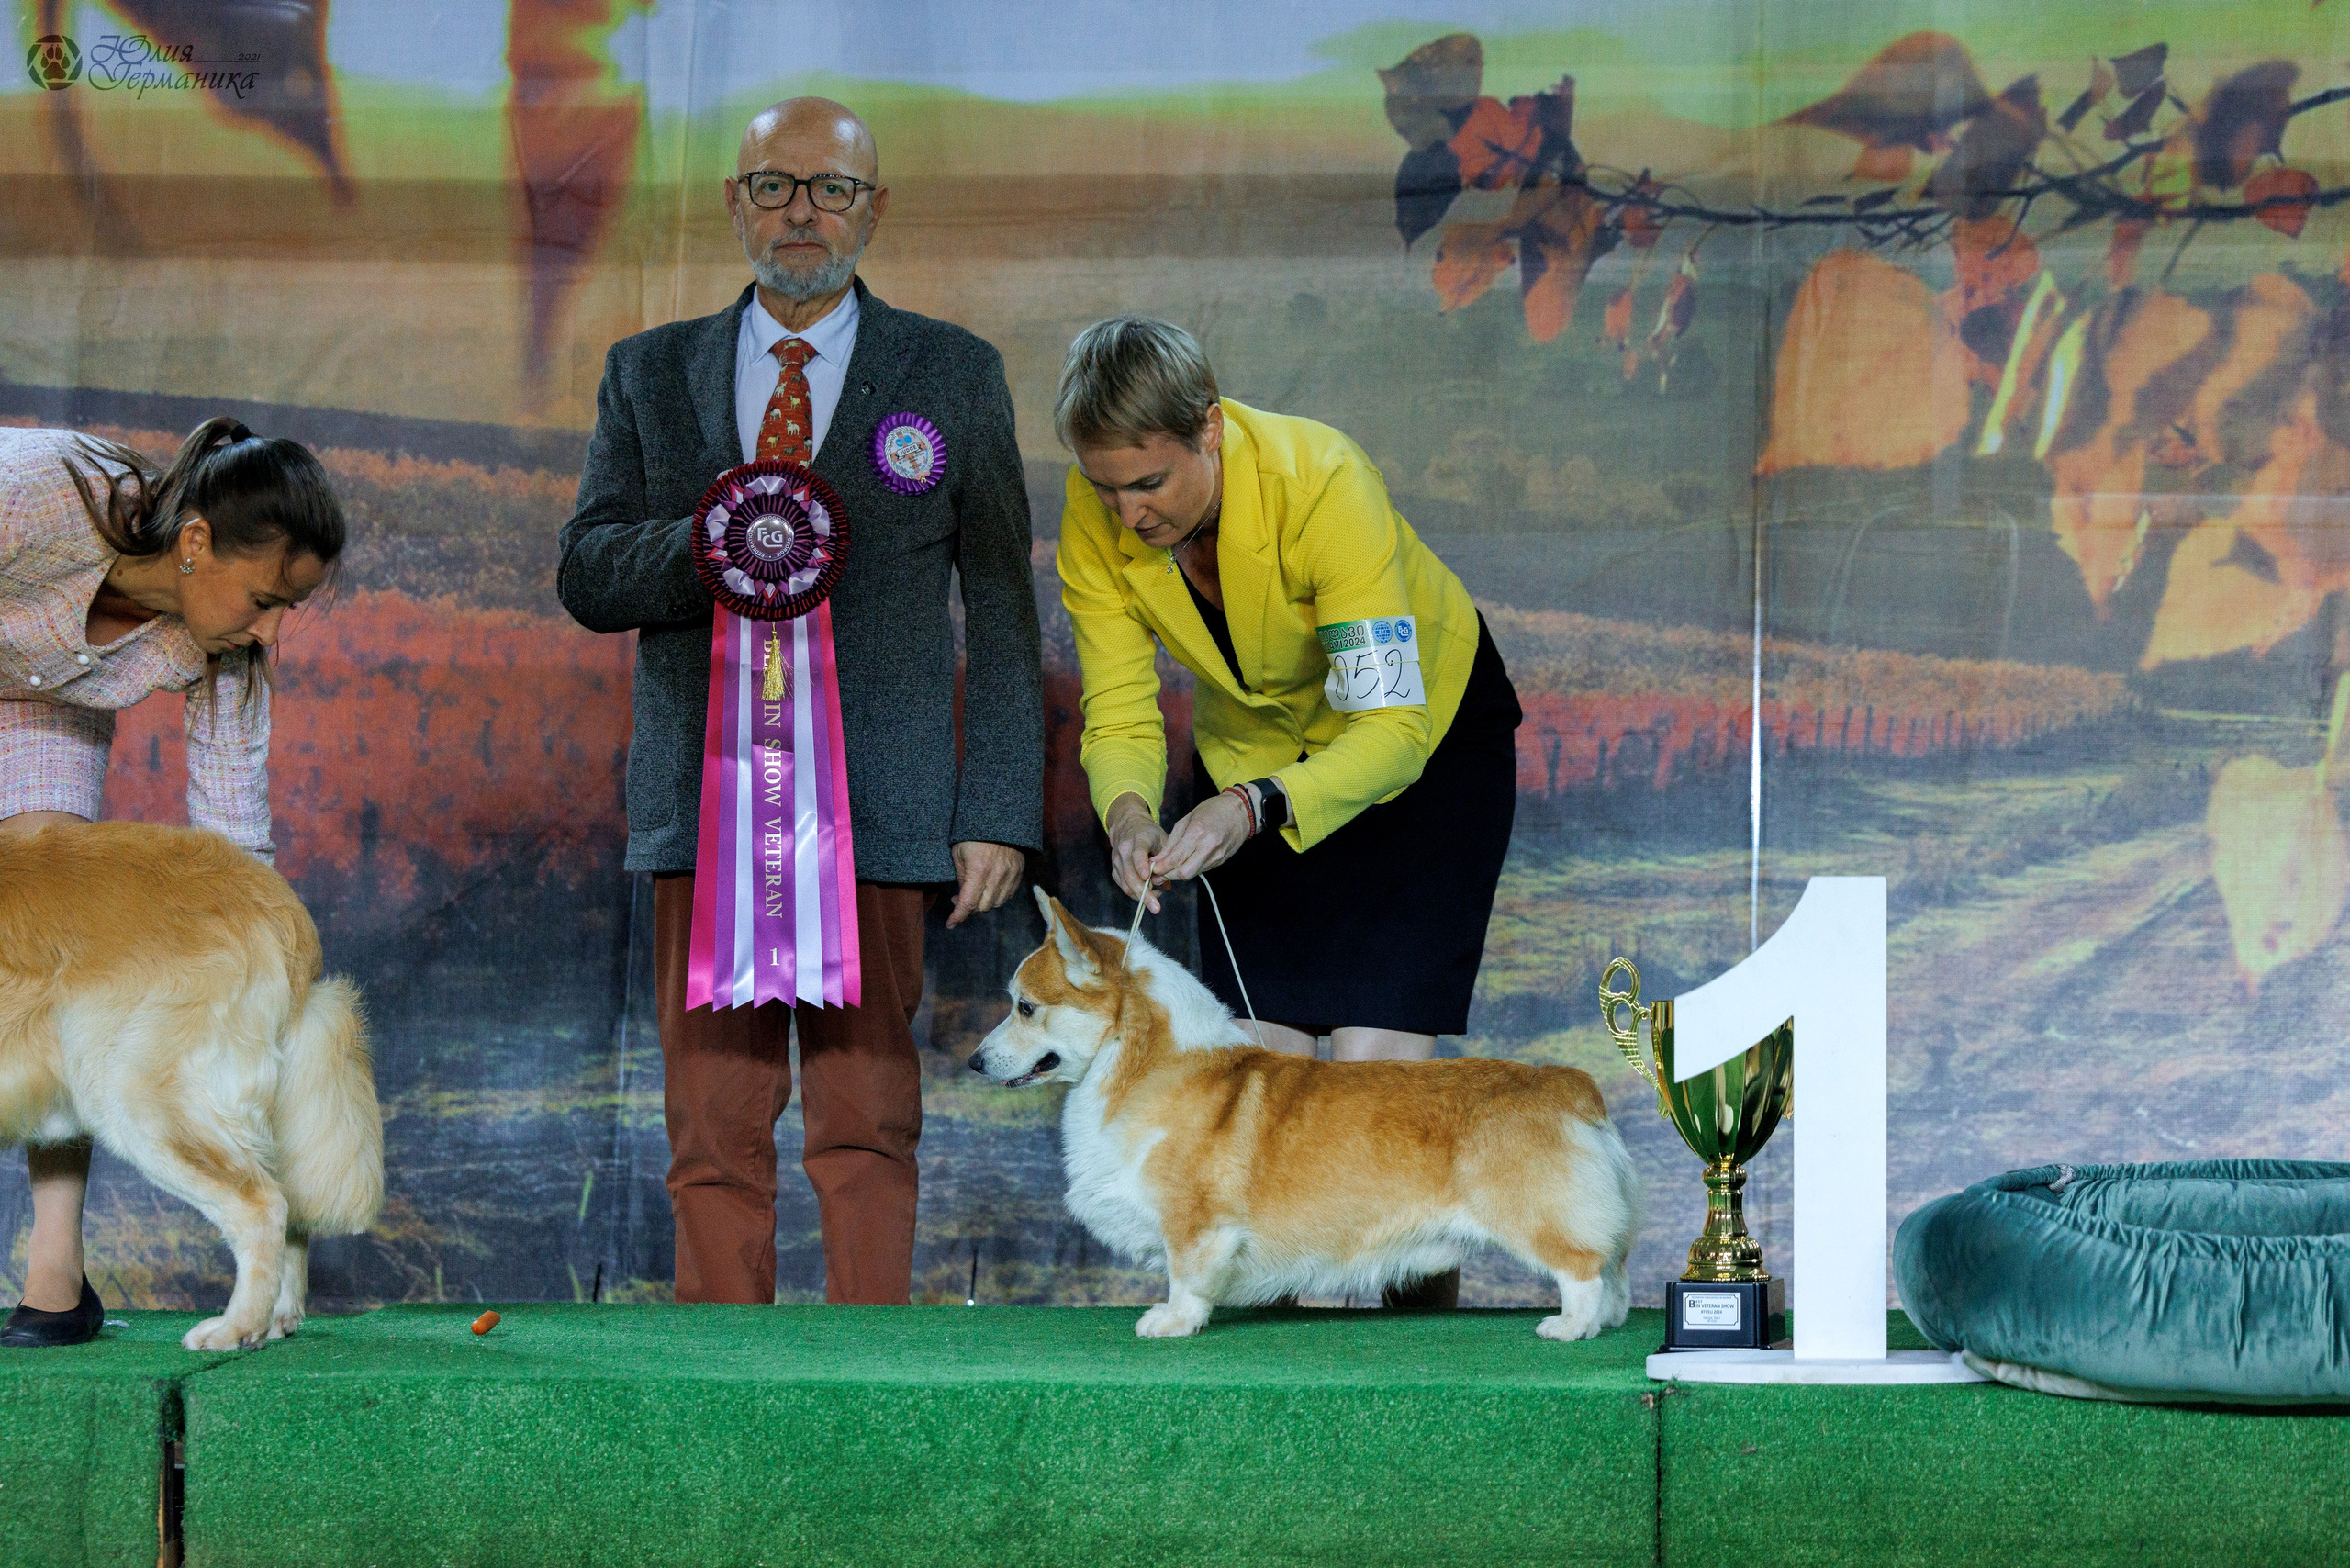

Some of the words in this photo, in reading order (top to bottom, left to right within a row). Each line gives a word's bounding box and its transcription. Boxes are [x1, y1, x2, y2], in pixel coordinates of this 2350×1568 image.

[900, 444, 917, 455] JUDGE
[757, 527, 783, 548] FCG
[1344, 636, 1366, 648] 2024
[1334, 649, 1411, 701] 052
[764, 702, 781, 728] IN
[763, 738, 782, 808] SHOW
[764, 817, 783, 918] VETERAN
[769, 947, 779, 967] 1
[1673, 875, 1887, 1360] 1
